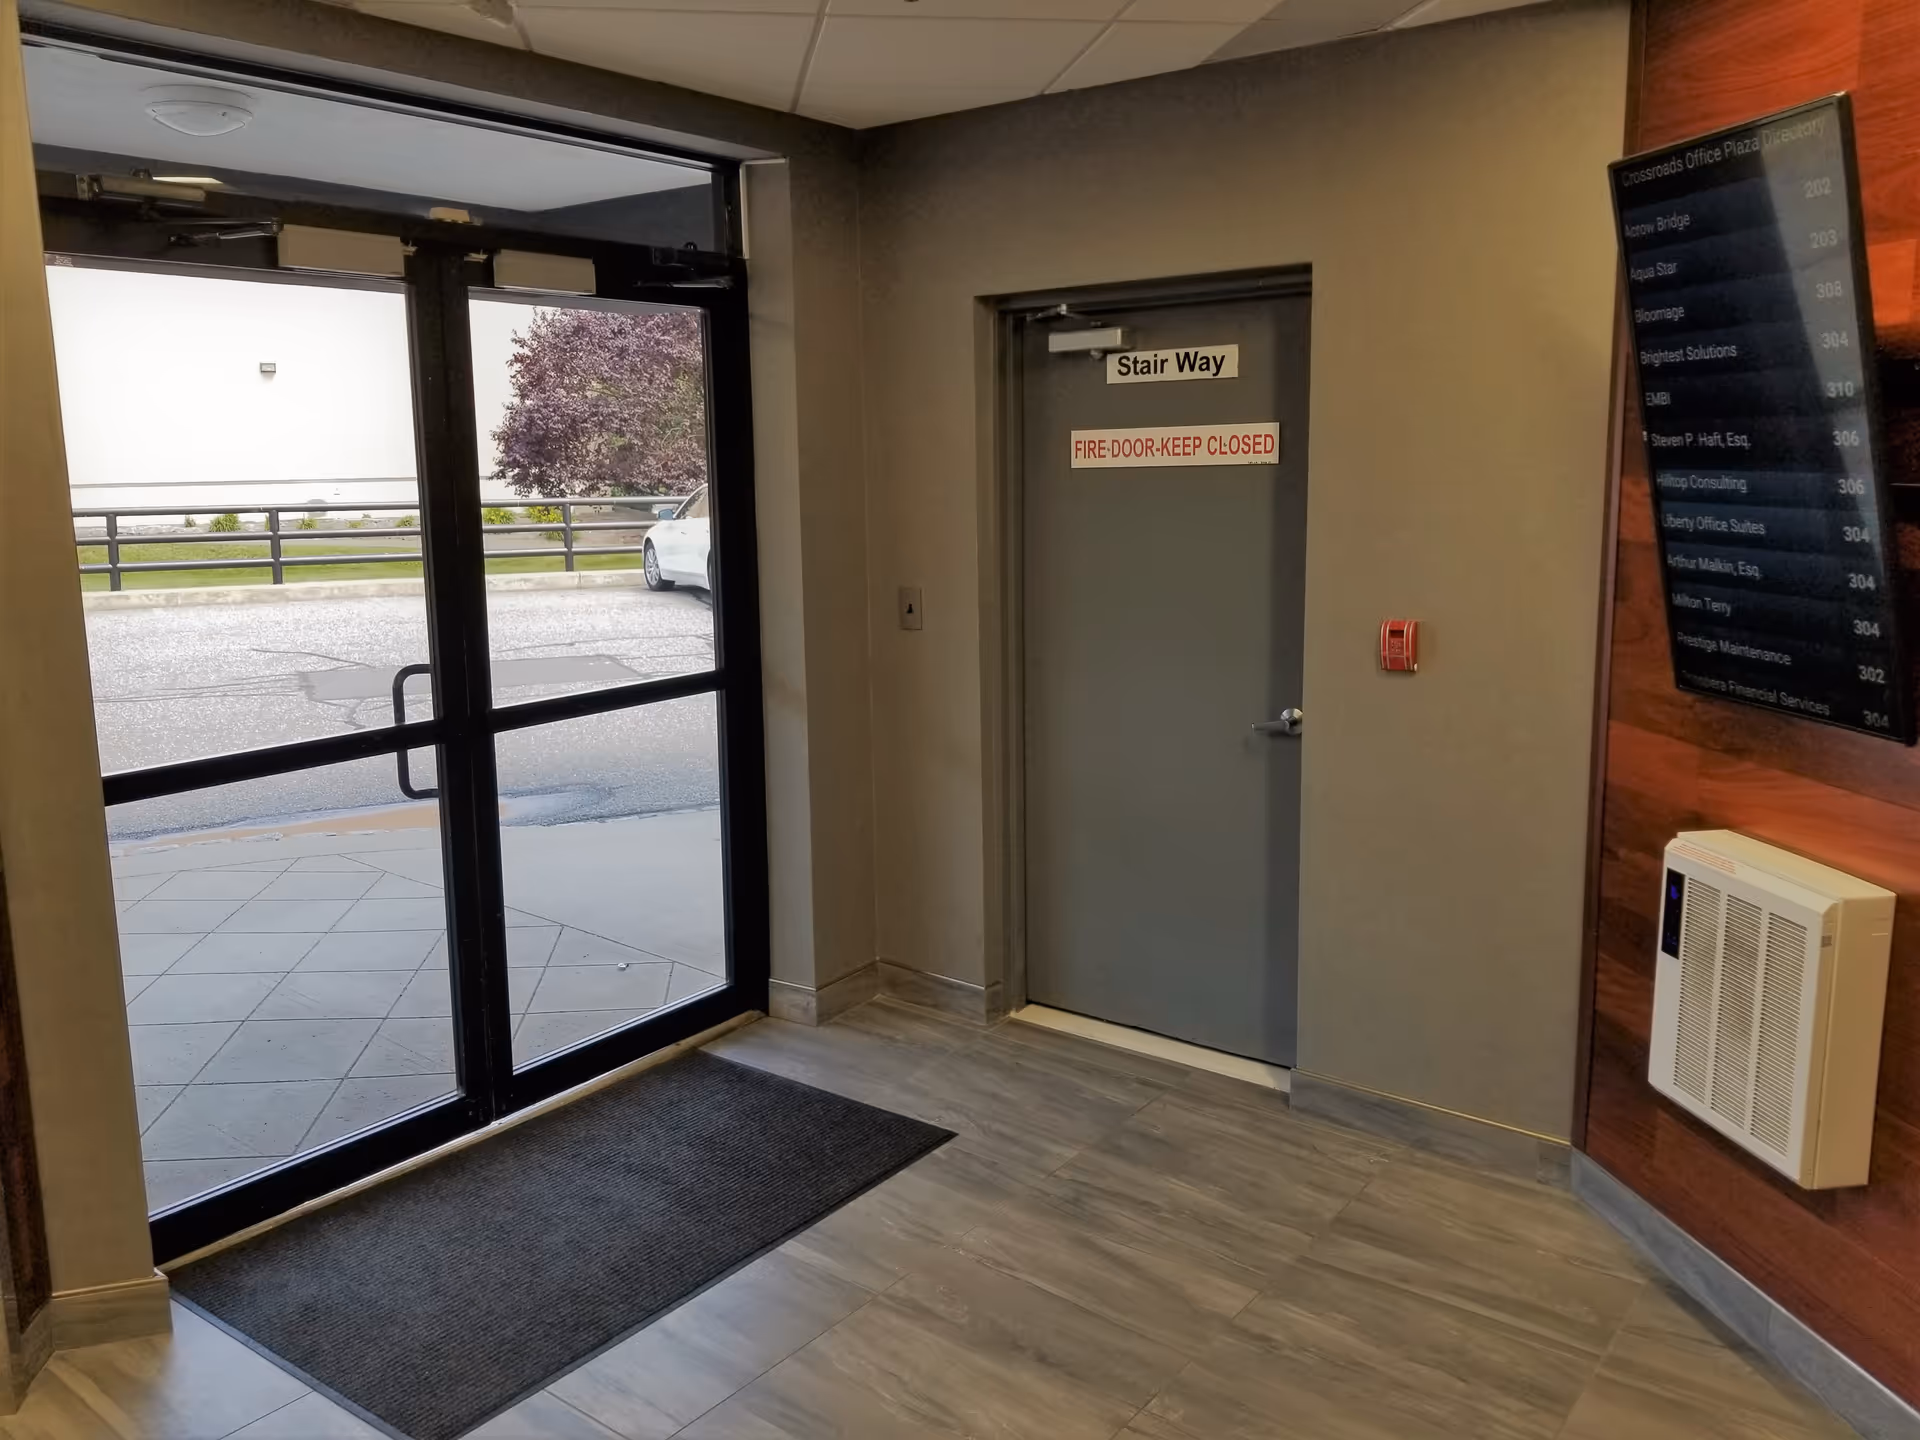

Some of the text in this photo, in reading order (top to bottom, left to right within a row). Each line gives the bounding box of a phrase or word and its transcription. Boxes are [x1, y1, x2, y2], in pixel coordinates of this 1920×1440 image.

[1622, 115, 1827, 187] Crossroads Office Plaza Directory
[1656, 211, 1690, 232] Bridge
[1805, 177, 1831, 198] 202
[1656, 262, 1678, 276] Star
[1809, 229, 1837, 248] 203
[1634, 281, 1842, 325] Bloomage 308
[1117, 351, 1225, 376] Stair Way
[1640, 332, 1848, 367] Brightest Solutions 304
[1827, 382, 1854, 398] 310
[1207, 434, 1275, 456] CLOSED
[1651, 433, 1684, 447] Steven
[1726, 432, 1752, 450] Esq.
[1832, 431, 1859, 447] 306
[1690, 474, 1747, 493] Consulting
[1837, 479, 1864, 495] 306
[1662, 514, 1870, 543] Liberty Office Suites 304
[1667, 553, 1697, 570] Arthur
[1849, 574, 1876, 590] 304
[1703, 597, 1731, 617] Terry
[1853, 620, 1880, 637] 304
[1677, 631, 1885, 684] Prestige Maintenance 302
[1728, 680, 1778, 704] Financial
[1780, 691, 1830, 717] Services
[1863, 711, 1889, 728] 304
